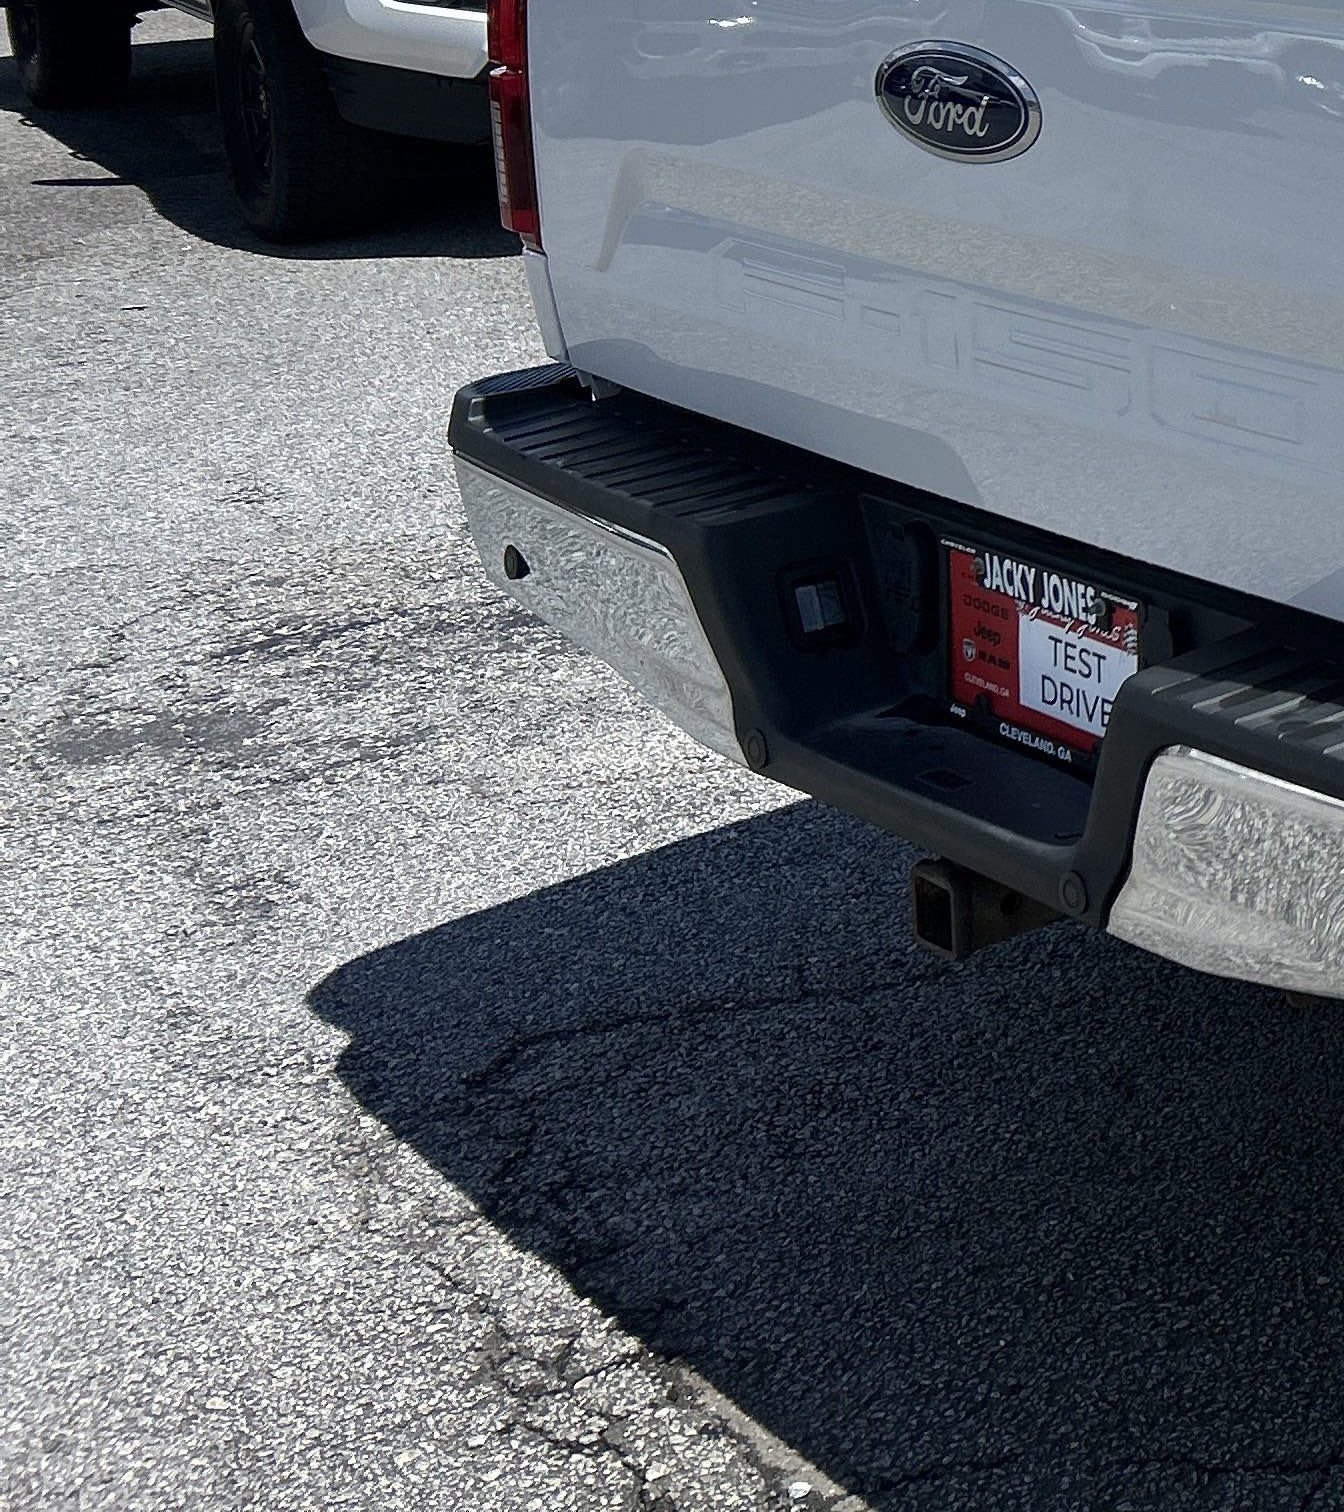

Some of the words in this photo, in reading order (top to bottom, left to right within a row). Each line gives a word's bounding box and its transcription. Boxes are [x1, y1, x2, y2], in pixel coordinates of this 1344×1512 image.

[904, 65, 989, 137] Ford
[962, 594, 1009, 619] DODGE
[983, 553, 1037, 602] JACKY
[1041, 571, 1096, 625] JONES
[974, 622, 1001, 647] Jeep
[978, 651, 1010, 670] RAM
[1048, 635, 1106, 683] TEST
[1041, 674, 1114, 727] DRIVE
[1058, 746, 1072, 763] GA
